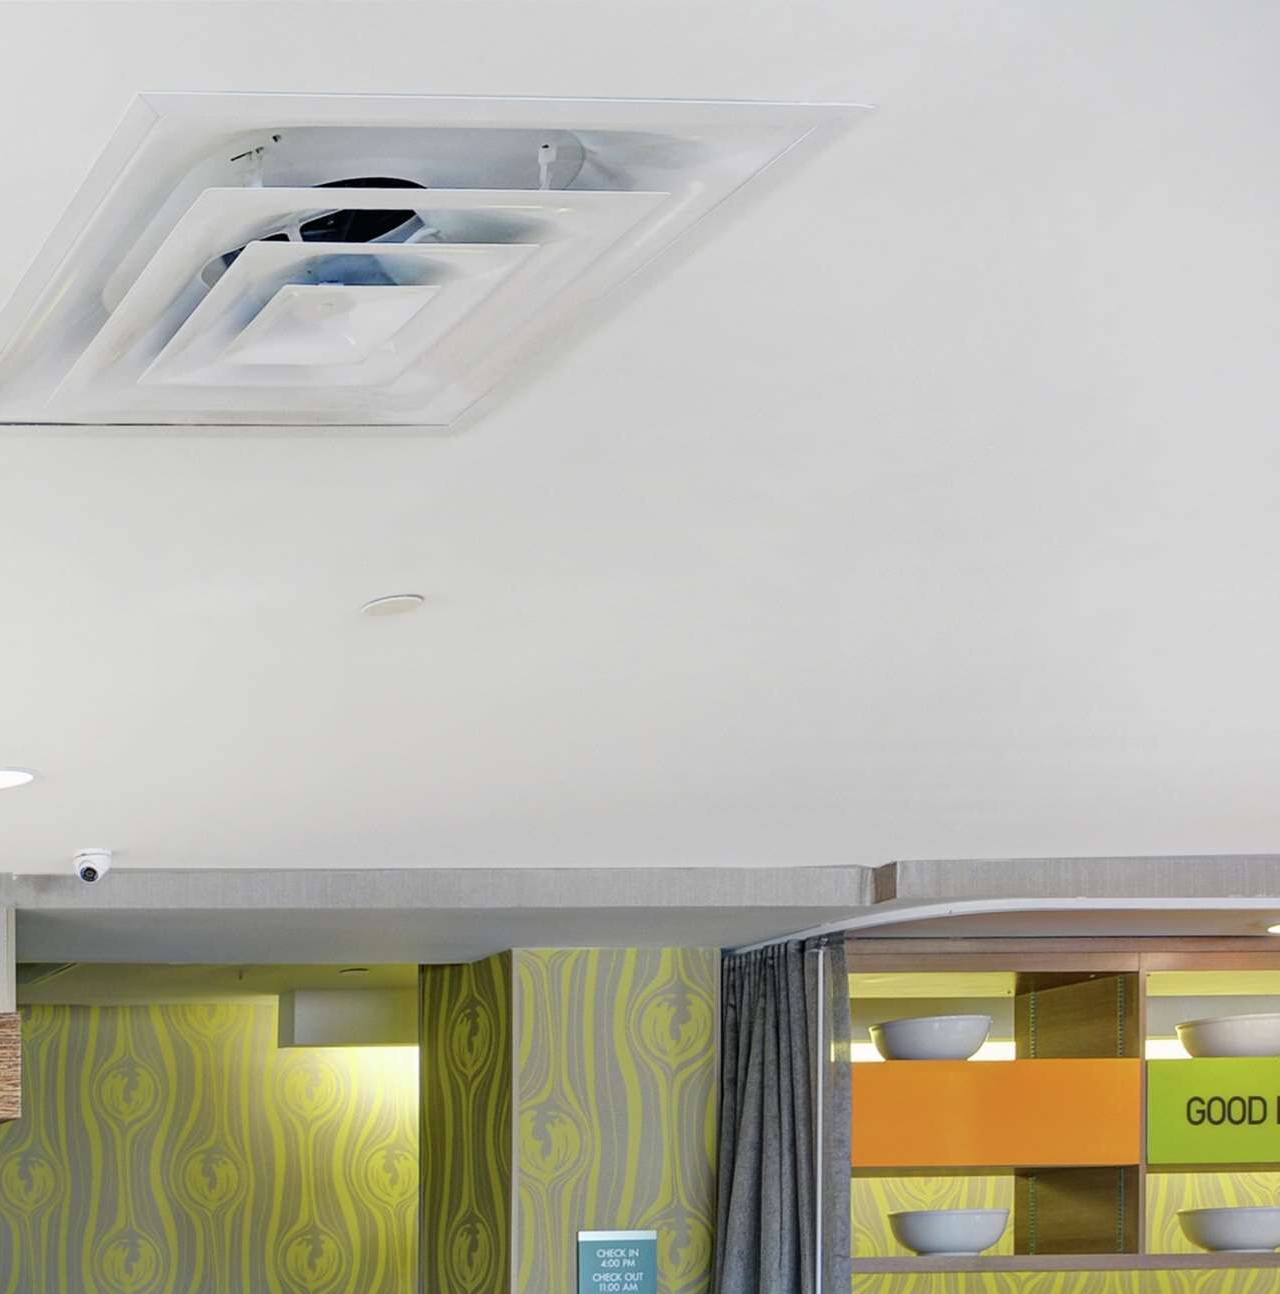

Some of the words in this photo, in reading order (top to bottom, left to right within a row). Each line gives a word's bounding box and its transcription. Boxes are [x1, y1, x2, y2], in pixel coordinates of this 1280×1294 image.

[1186, 1095, 1267, 1126] GOOD
[596, 1248, 626, 1258] CHECK
[628, 1248, 640, 1257] IN
[600, 1259, 621, 1268] 4:00
[622, 1259, 636, 1268] PM
[593, 1273, 623, 1282] CHECK
[624, 1272, 644, 1282] OUT
[622, 1283, 639, 1292] AM
